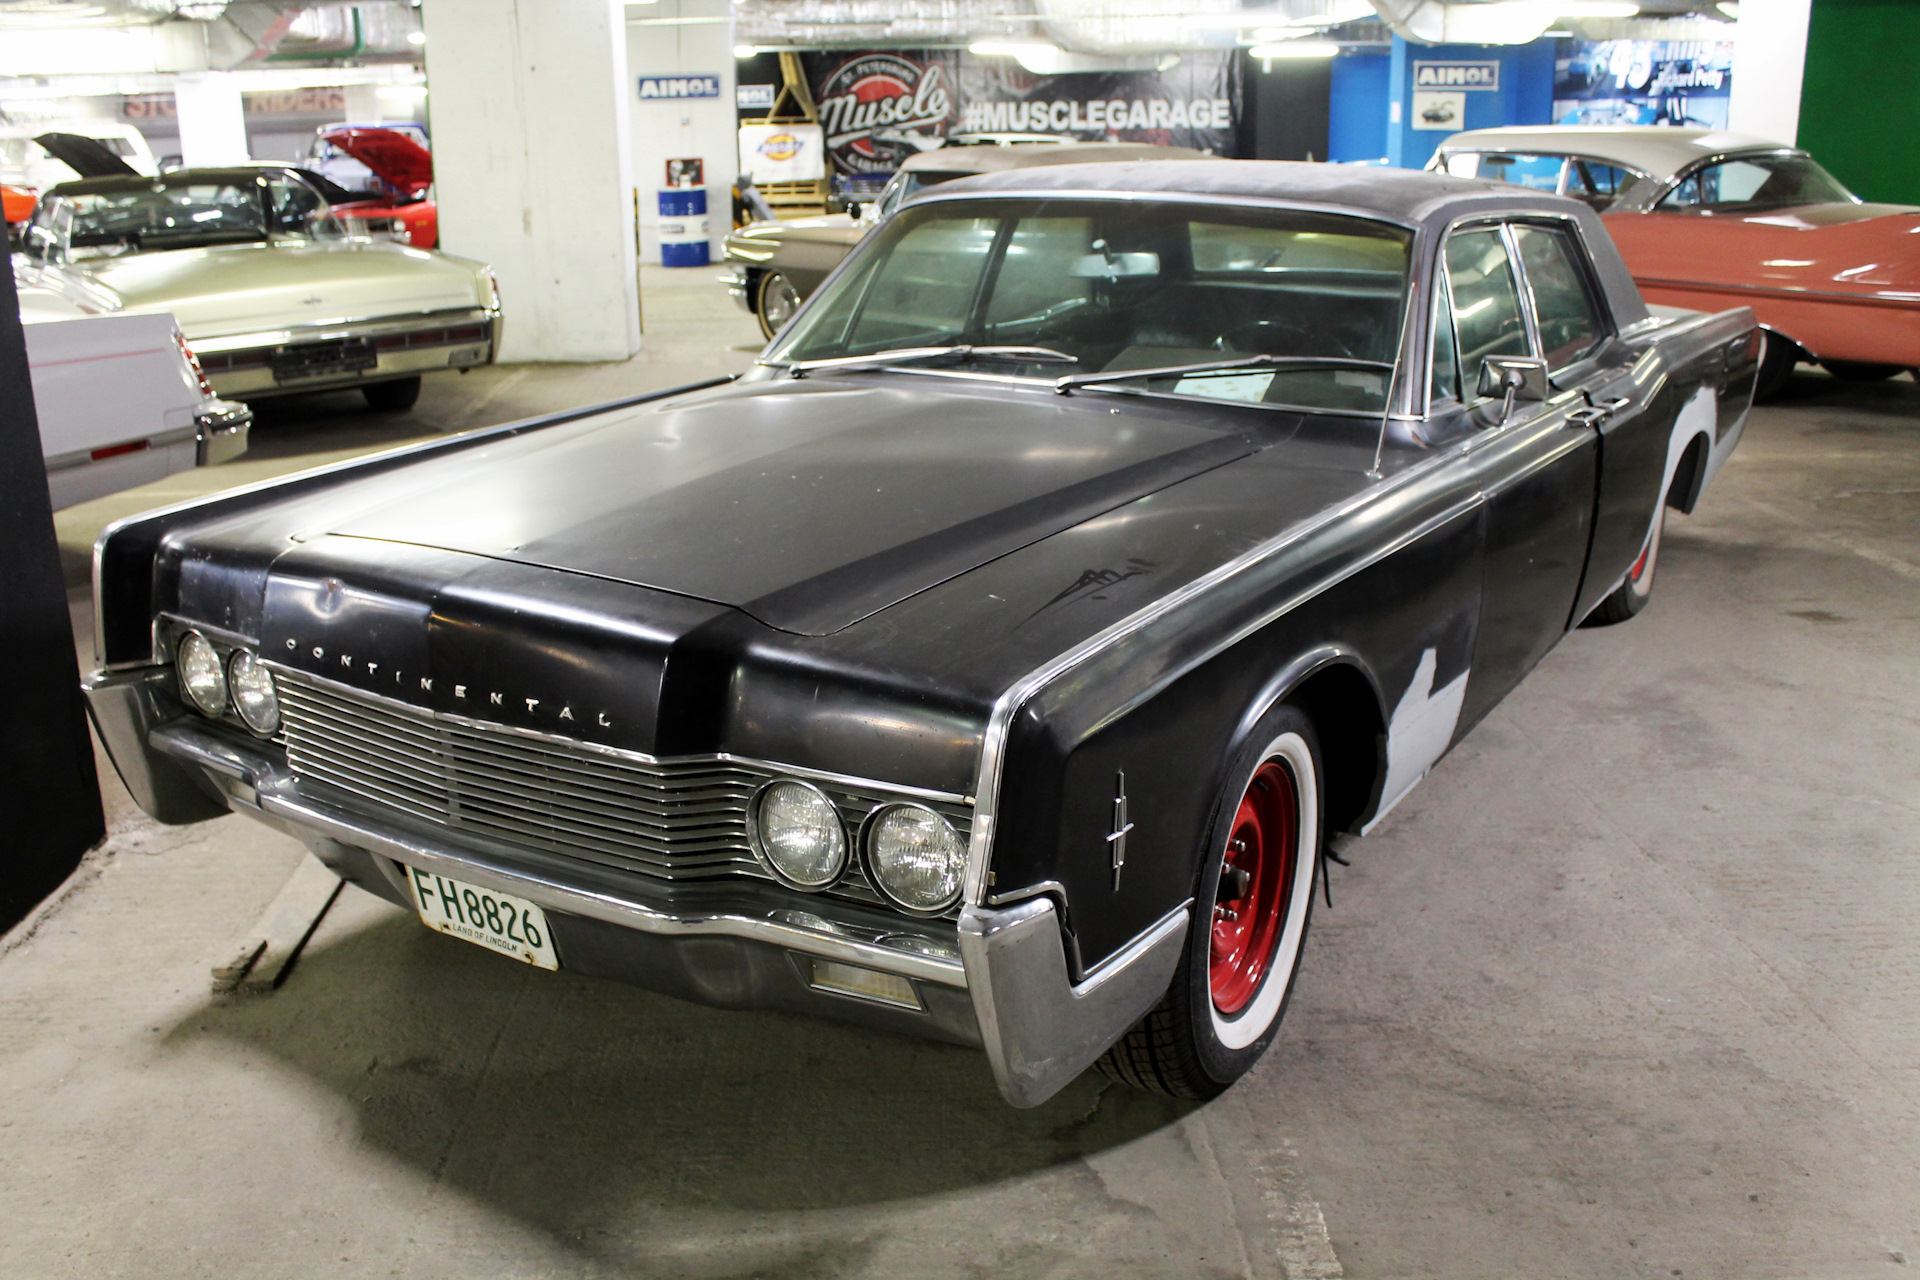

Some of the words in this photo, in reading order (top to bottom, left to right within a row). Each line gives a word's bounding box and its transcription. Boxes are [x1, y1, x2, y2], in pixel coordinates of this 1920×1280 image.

[639, 78, 718, 98] AIMOL
[1418, 66, 1494, 86] AIMOL
[817, 65, 950, 136] Muscle
[964, 99, 1231, 132] #MUSCLEGARAGE
[286, 638, 611, 728] CONTINENTAL
[411, 867, 543, 949] FH8826
[452, 923, 473, 937] LAND
[474, 929, 484, 940] OF
[486, 934, 518, 952] LINCOLN
